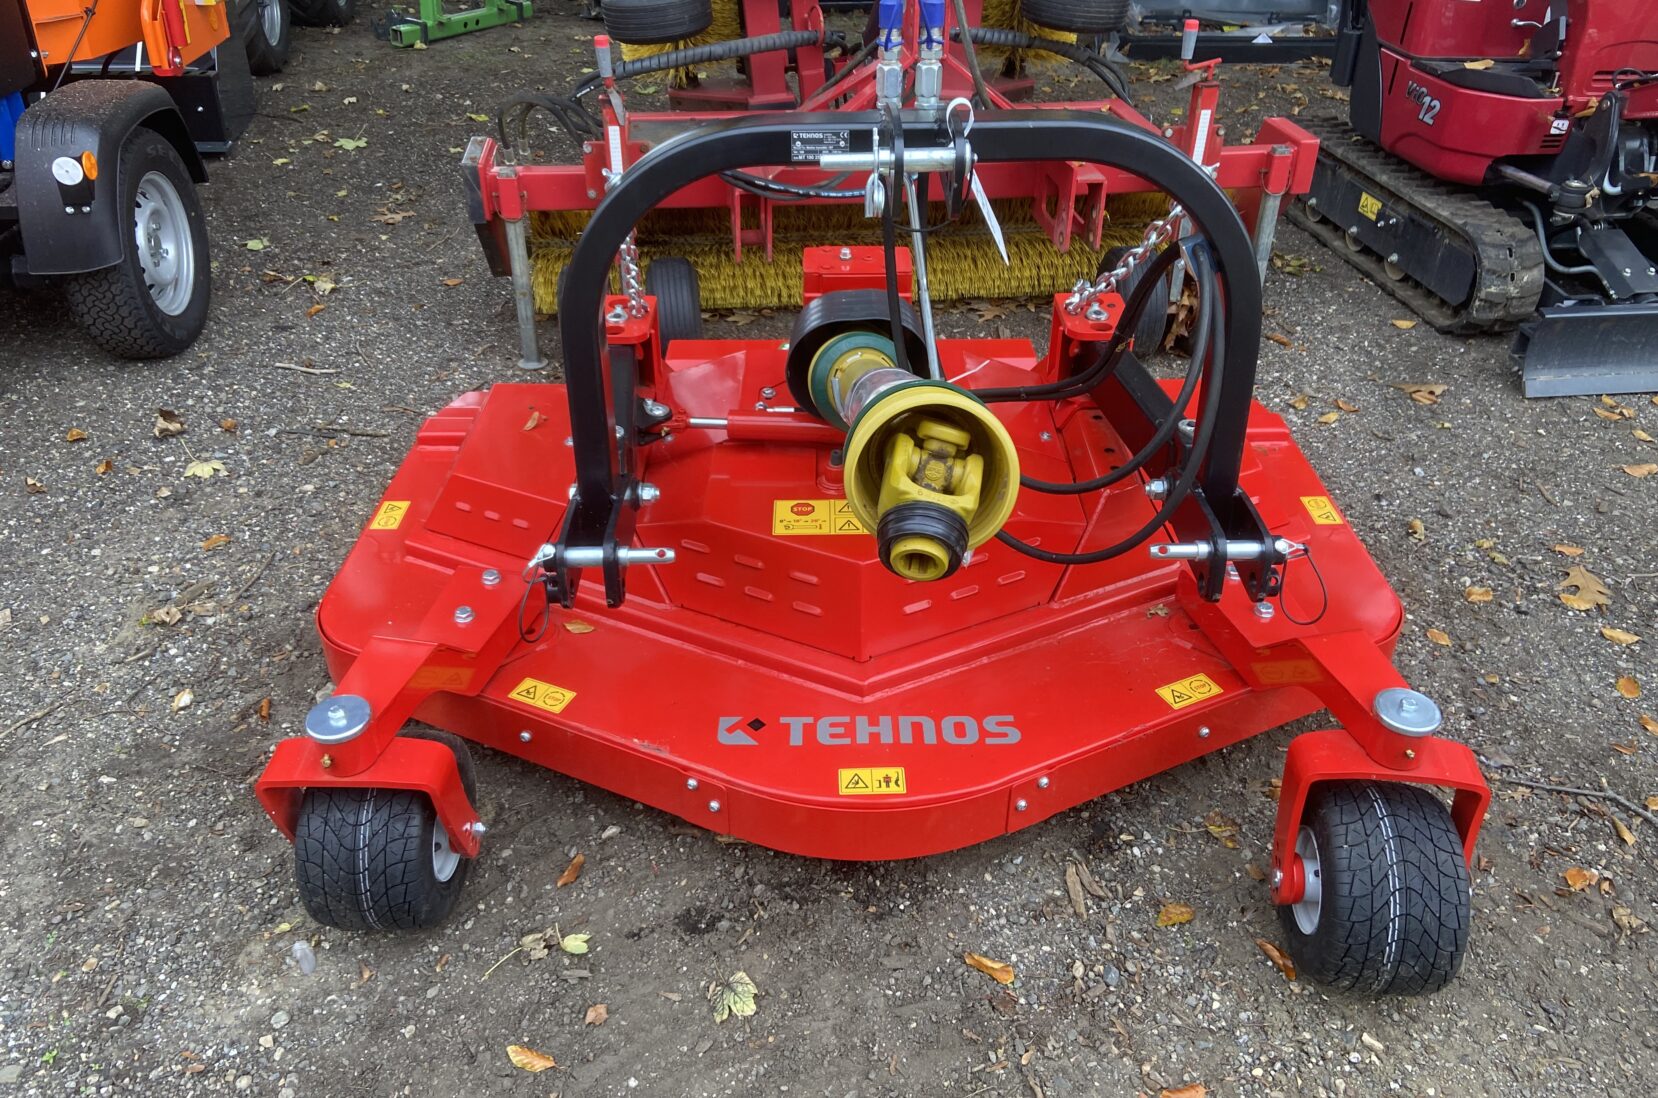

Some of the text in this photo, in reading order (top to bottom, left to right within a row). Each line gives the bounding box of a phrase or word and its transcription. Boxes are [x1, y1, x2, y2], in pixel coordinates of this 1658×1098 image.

[1418, 95, 1441, 126] 12
[792, 505, 813, 513] STOP
[779, 715, 1022, 747] TEHNOS
